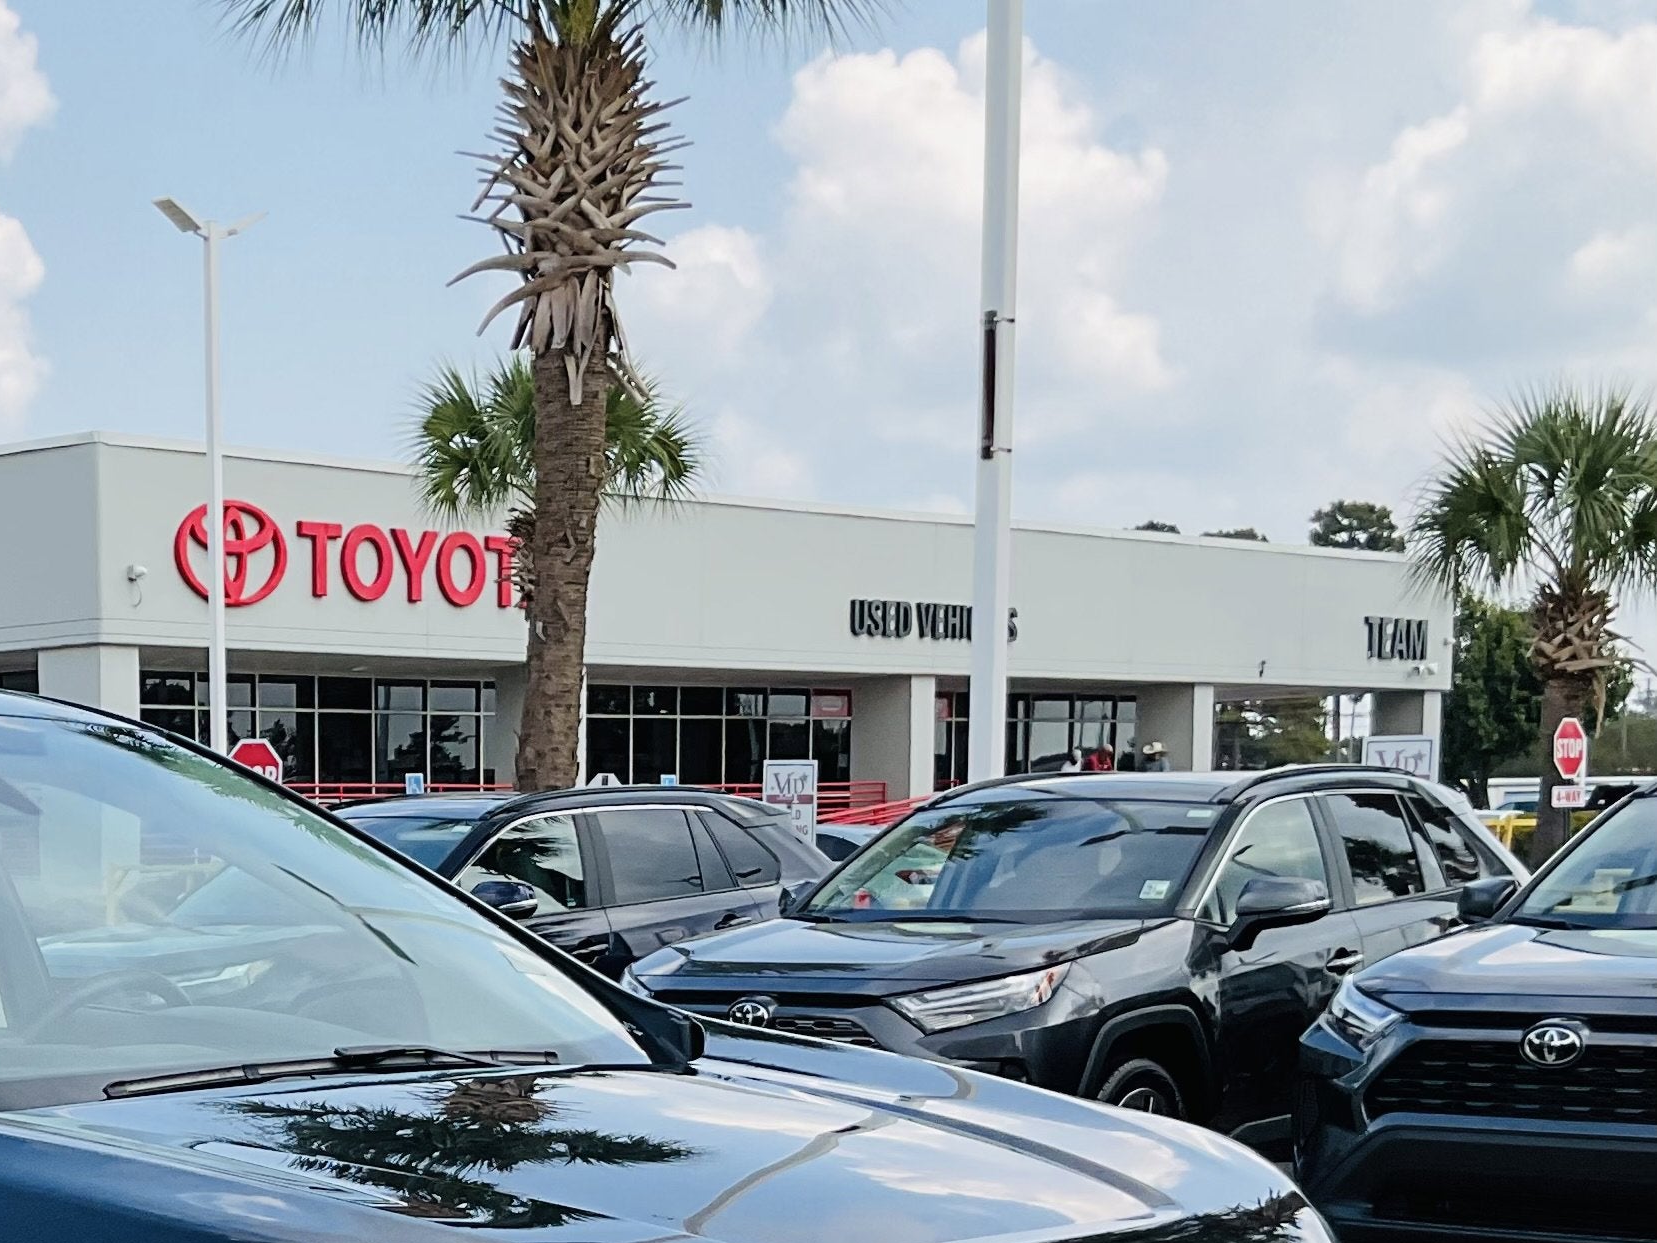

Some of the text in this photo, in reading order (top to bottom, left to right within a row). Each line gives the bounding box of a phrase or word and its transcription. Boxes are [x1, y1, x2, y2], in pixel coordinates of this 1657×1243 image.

[296, 521, 527, 608] TOYOT
[850, 599, 1018, 643] USED VEHIS
[1364, 616, 1428, 661] TEAM
[1557, 738, 1582, 758] STOP
[1556, 790, 1581, 803] 4-WAY
